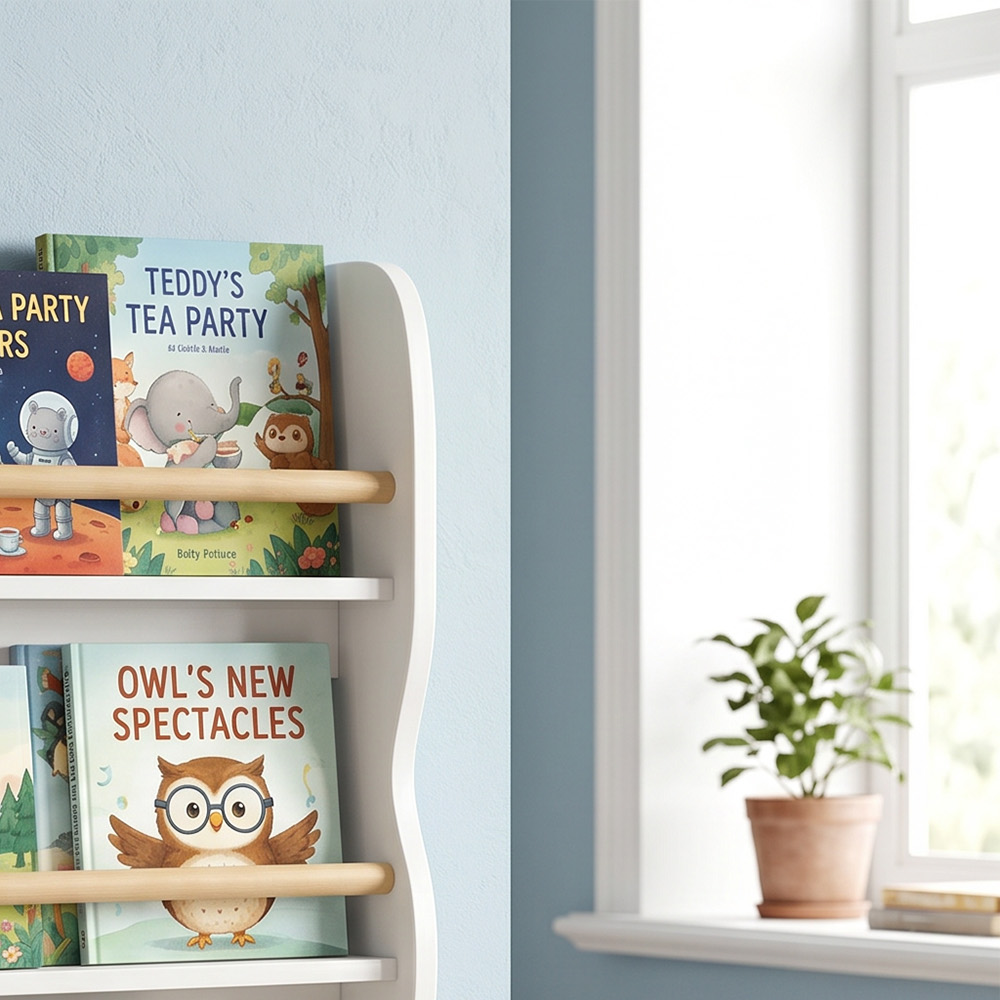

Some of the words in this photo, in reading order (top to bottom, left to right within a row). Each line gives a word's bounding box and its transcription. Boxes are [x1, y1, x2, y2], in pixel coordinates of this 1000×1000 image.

[145, 267, 244, 298] TEDDY'S
[12, 293, 89, 323] PARTY
[126, 305, 176, 335] TEA
[185, 308, 268, 338] PARTY
[118, 665, 213, 698] OWL'S
[227, 665, 294, 697] NEW
[113, 706, 304, 740] SPECTACLES
